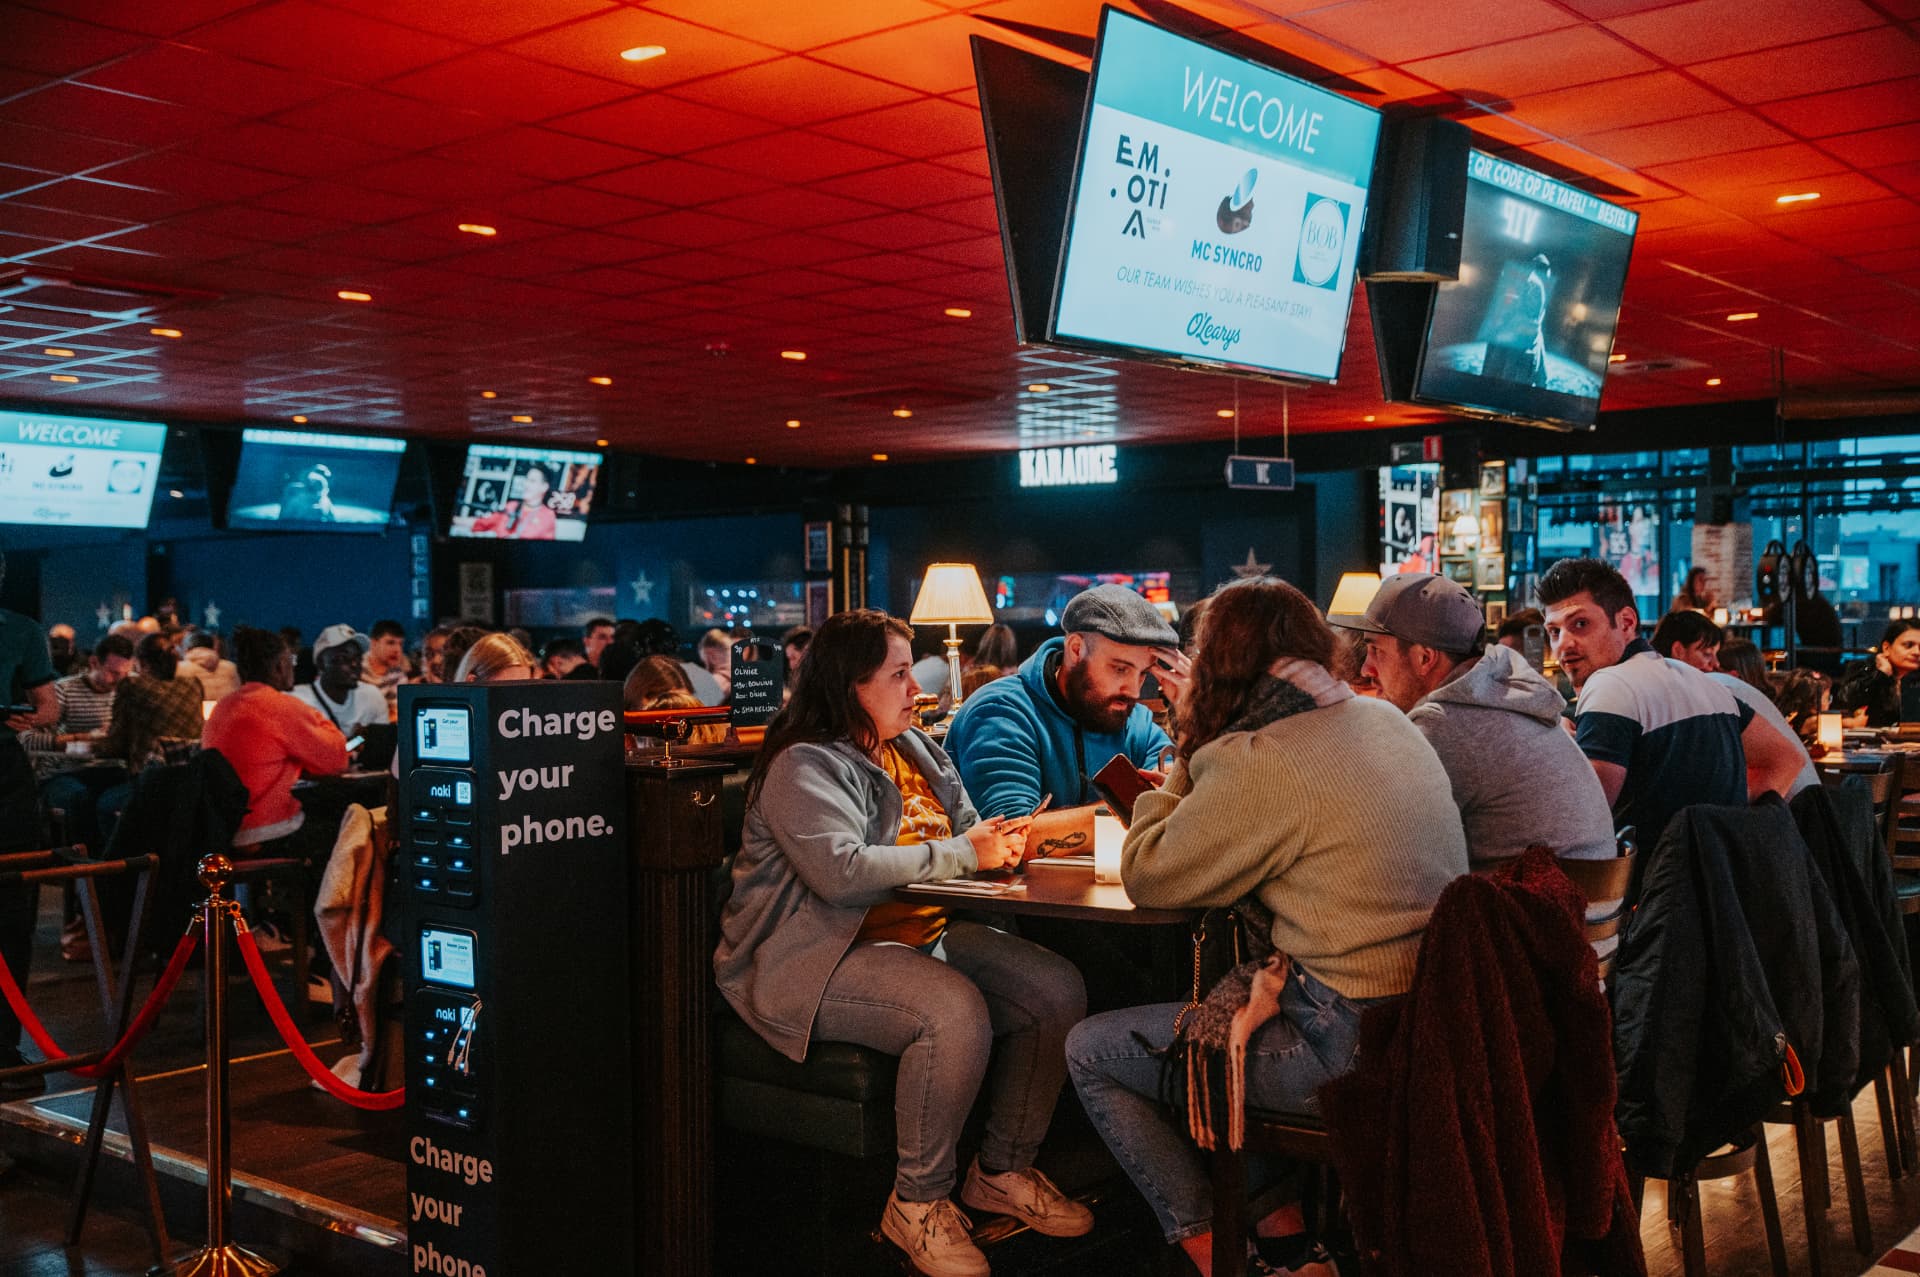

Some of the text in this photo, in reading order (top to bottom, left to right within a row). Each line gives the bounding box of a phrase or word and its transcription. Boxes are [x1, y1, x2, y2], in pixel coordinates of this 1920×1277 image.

[1183, 66, 1324, 154] WELCOME
[1474, 158, 1493, 178] QR
[1494, 163, 1523, 190] CODE
[1524, 175, 1541, 195] OP
[1542, 181, 1555, 203] DE
[1598, 202, 1626, 228] BESTEL
[1307, 220, 1337, 249] BOB
[1191, 239, 1263, 272] MC SYNCRO
[1117, 266, 1141, 284] OUR
[1143, 272, 1171, 289] TEAM
[1174, 277, 1210, 299] WISHES
[1214, 288, 1233, 304] YOU
[1236, 293, 1243, 304] A
[1247, 293, 1289, 314] PLEASANT
[1186, 312, 1241, 351] O'Learys
[18, 420, 123, 447] WELCOME
[1019, 444, 1118, 487] KARAOKE
[498, 708, 616, 740] Charge
[431, 784, 451, 798] naki
[498, 764, 574, 800] your
[501, 814, 614, 855] phone.
[436, 1007, 456, 1022] naki
[410, 1136, 493, 1185] Charge
[410, 1192, 463, 1227] your
[413, 1241, 487, 1277] phone
